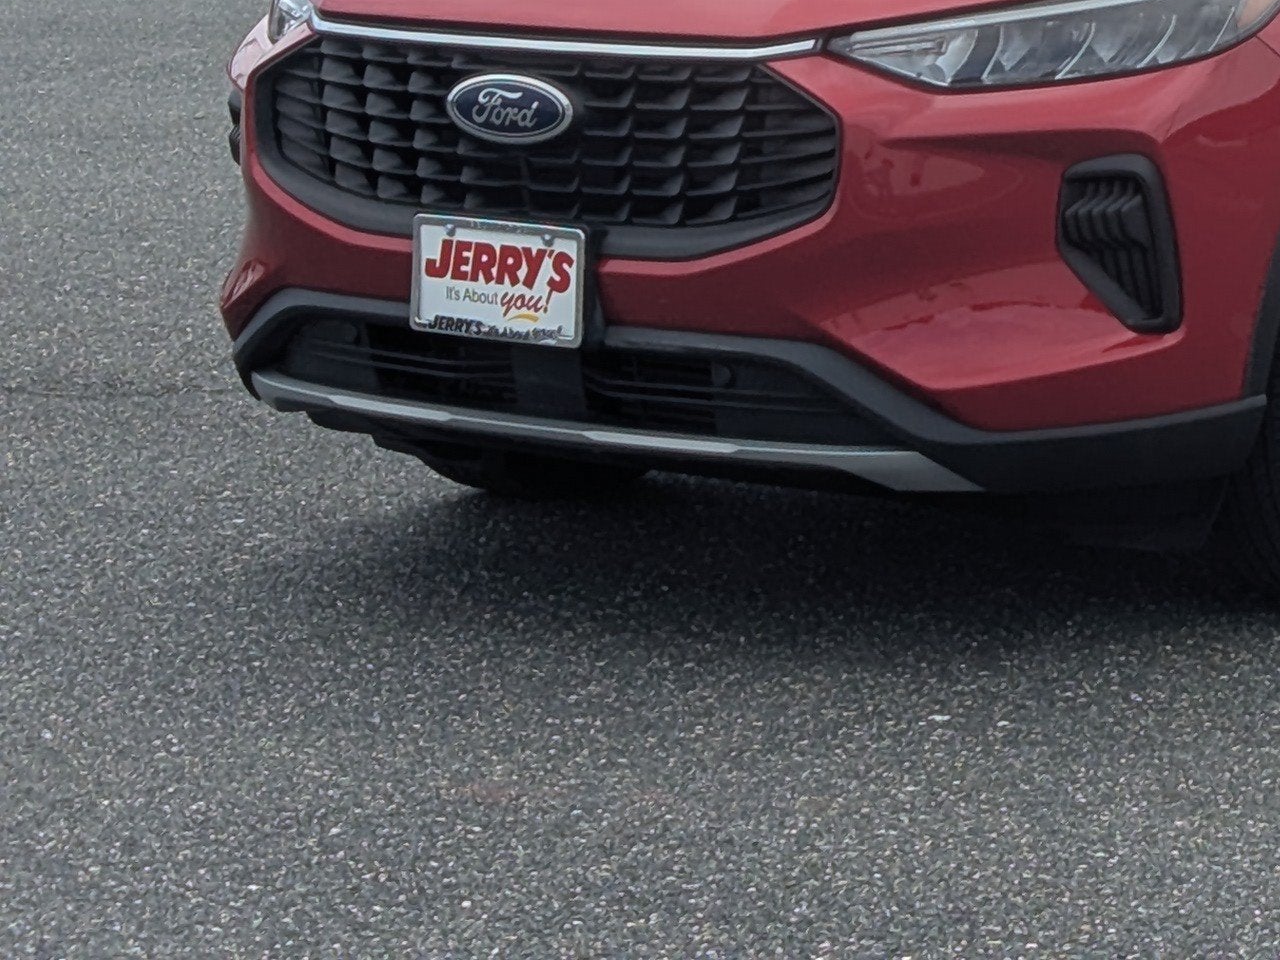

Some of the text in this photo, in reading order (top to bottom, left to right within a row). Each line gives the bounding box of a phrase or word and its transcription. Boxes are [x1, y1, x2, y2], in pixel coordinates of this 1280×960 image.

[472, 87, 540, 128] Ford
[424, 238, 575, 294] JERRY'S
[445, 285, 555, 318] It's About you!
